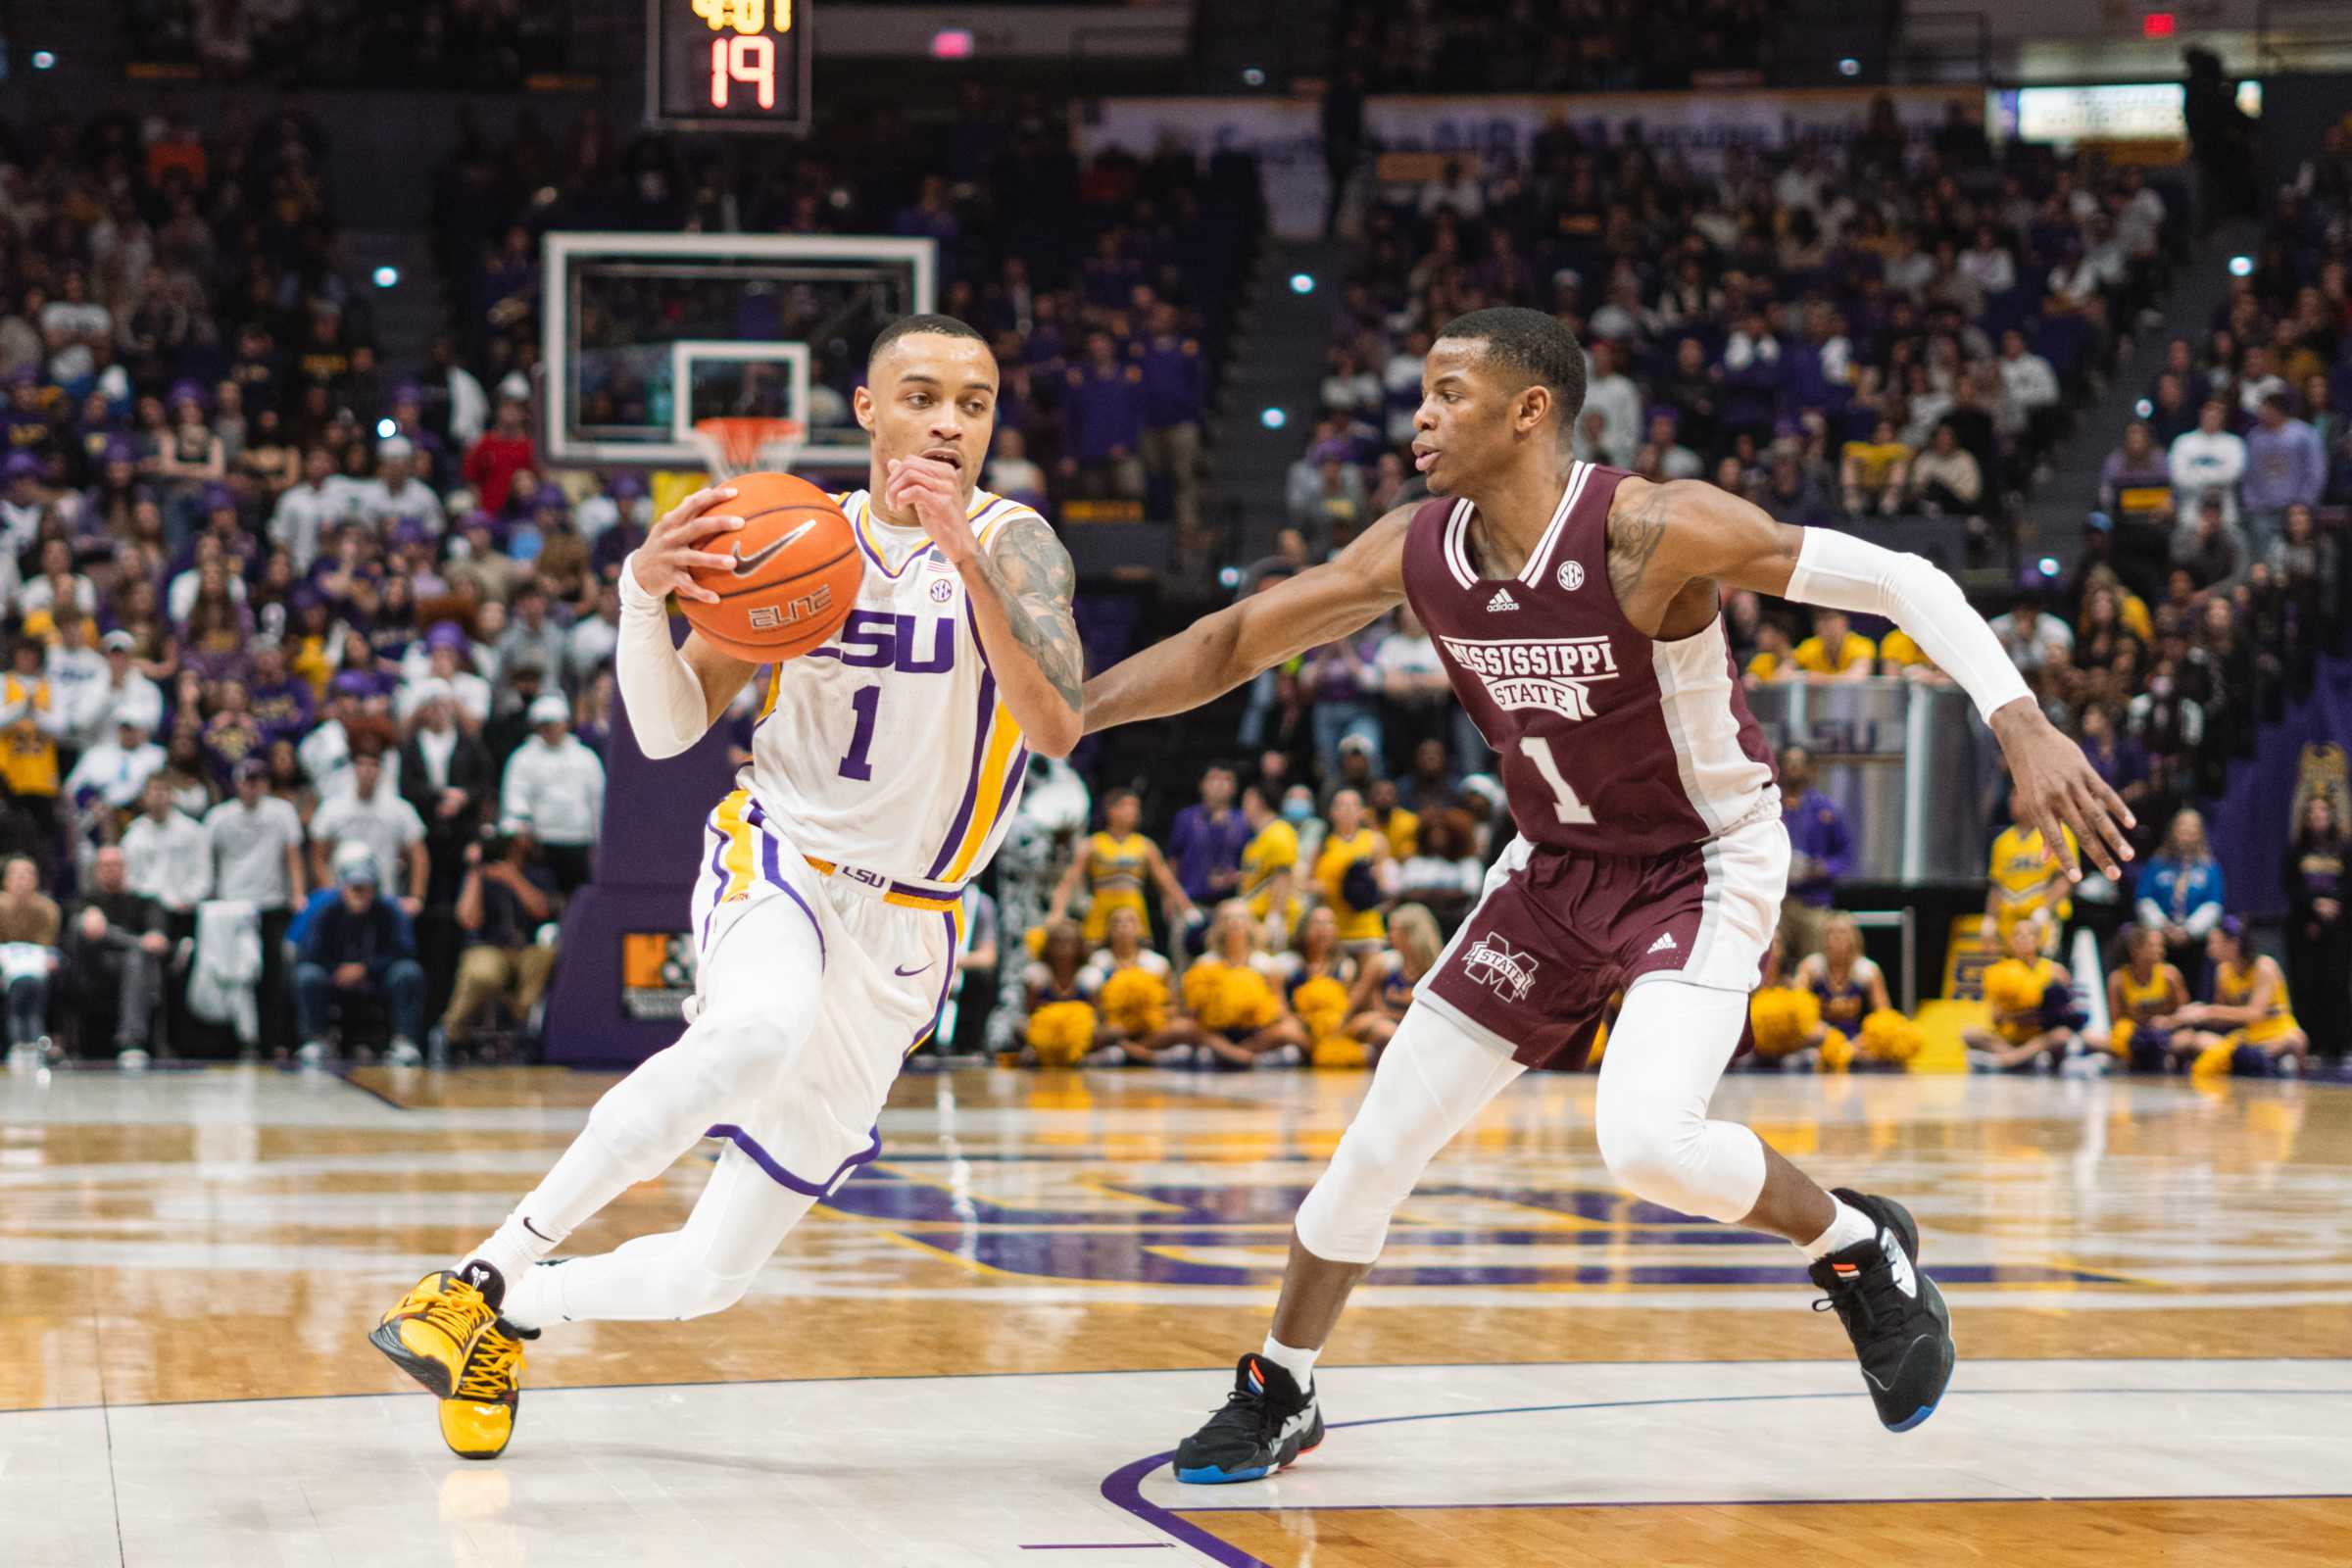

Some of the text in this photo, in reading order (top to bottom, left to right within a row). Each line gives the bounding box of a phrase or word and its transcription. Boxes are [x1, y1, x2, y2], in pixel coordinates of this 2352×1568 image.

[711, 36, 774, 109] 19
[931, 580, 952, 602] SEC
[1559, 562, 1583, 590] SEC
[749, 583, 831, 628] ELITE
[1487, 602, 1519, 612] adidas
[806, 610, 955, 673] SU
[1445, 642, 1617, 675] MISSISSIPPI
[1494, 682, 1568, 711] STATE
[838, 685, 881, 781] 1
[1519, 737, 1597, 823] 1
[842, 865, 886, 888] LSU
[1480, 950, 1527, 986] STATE
